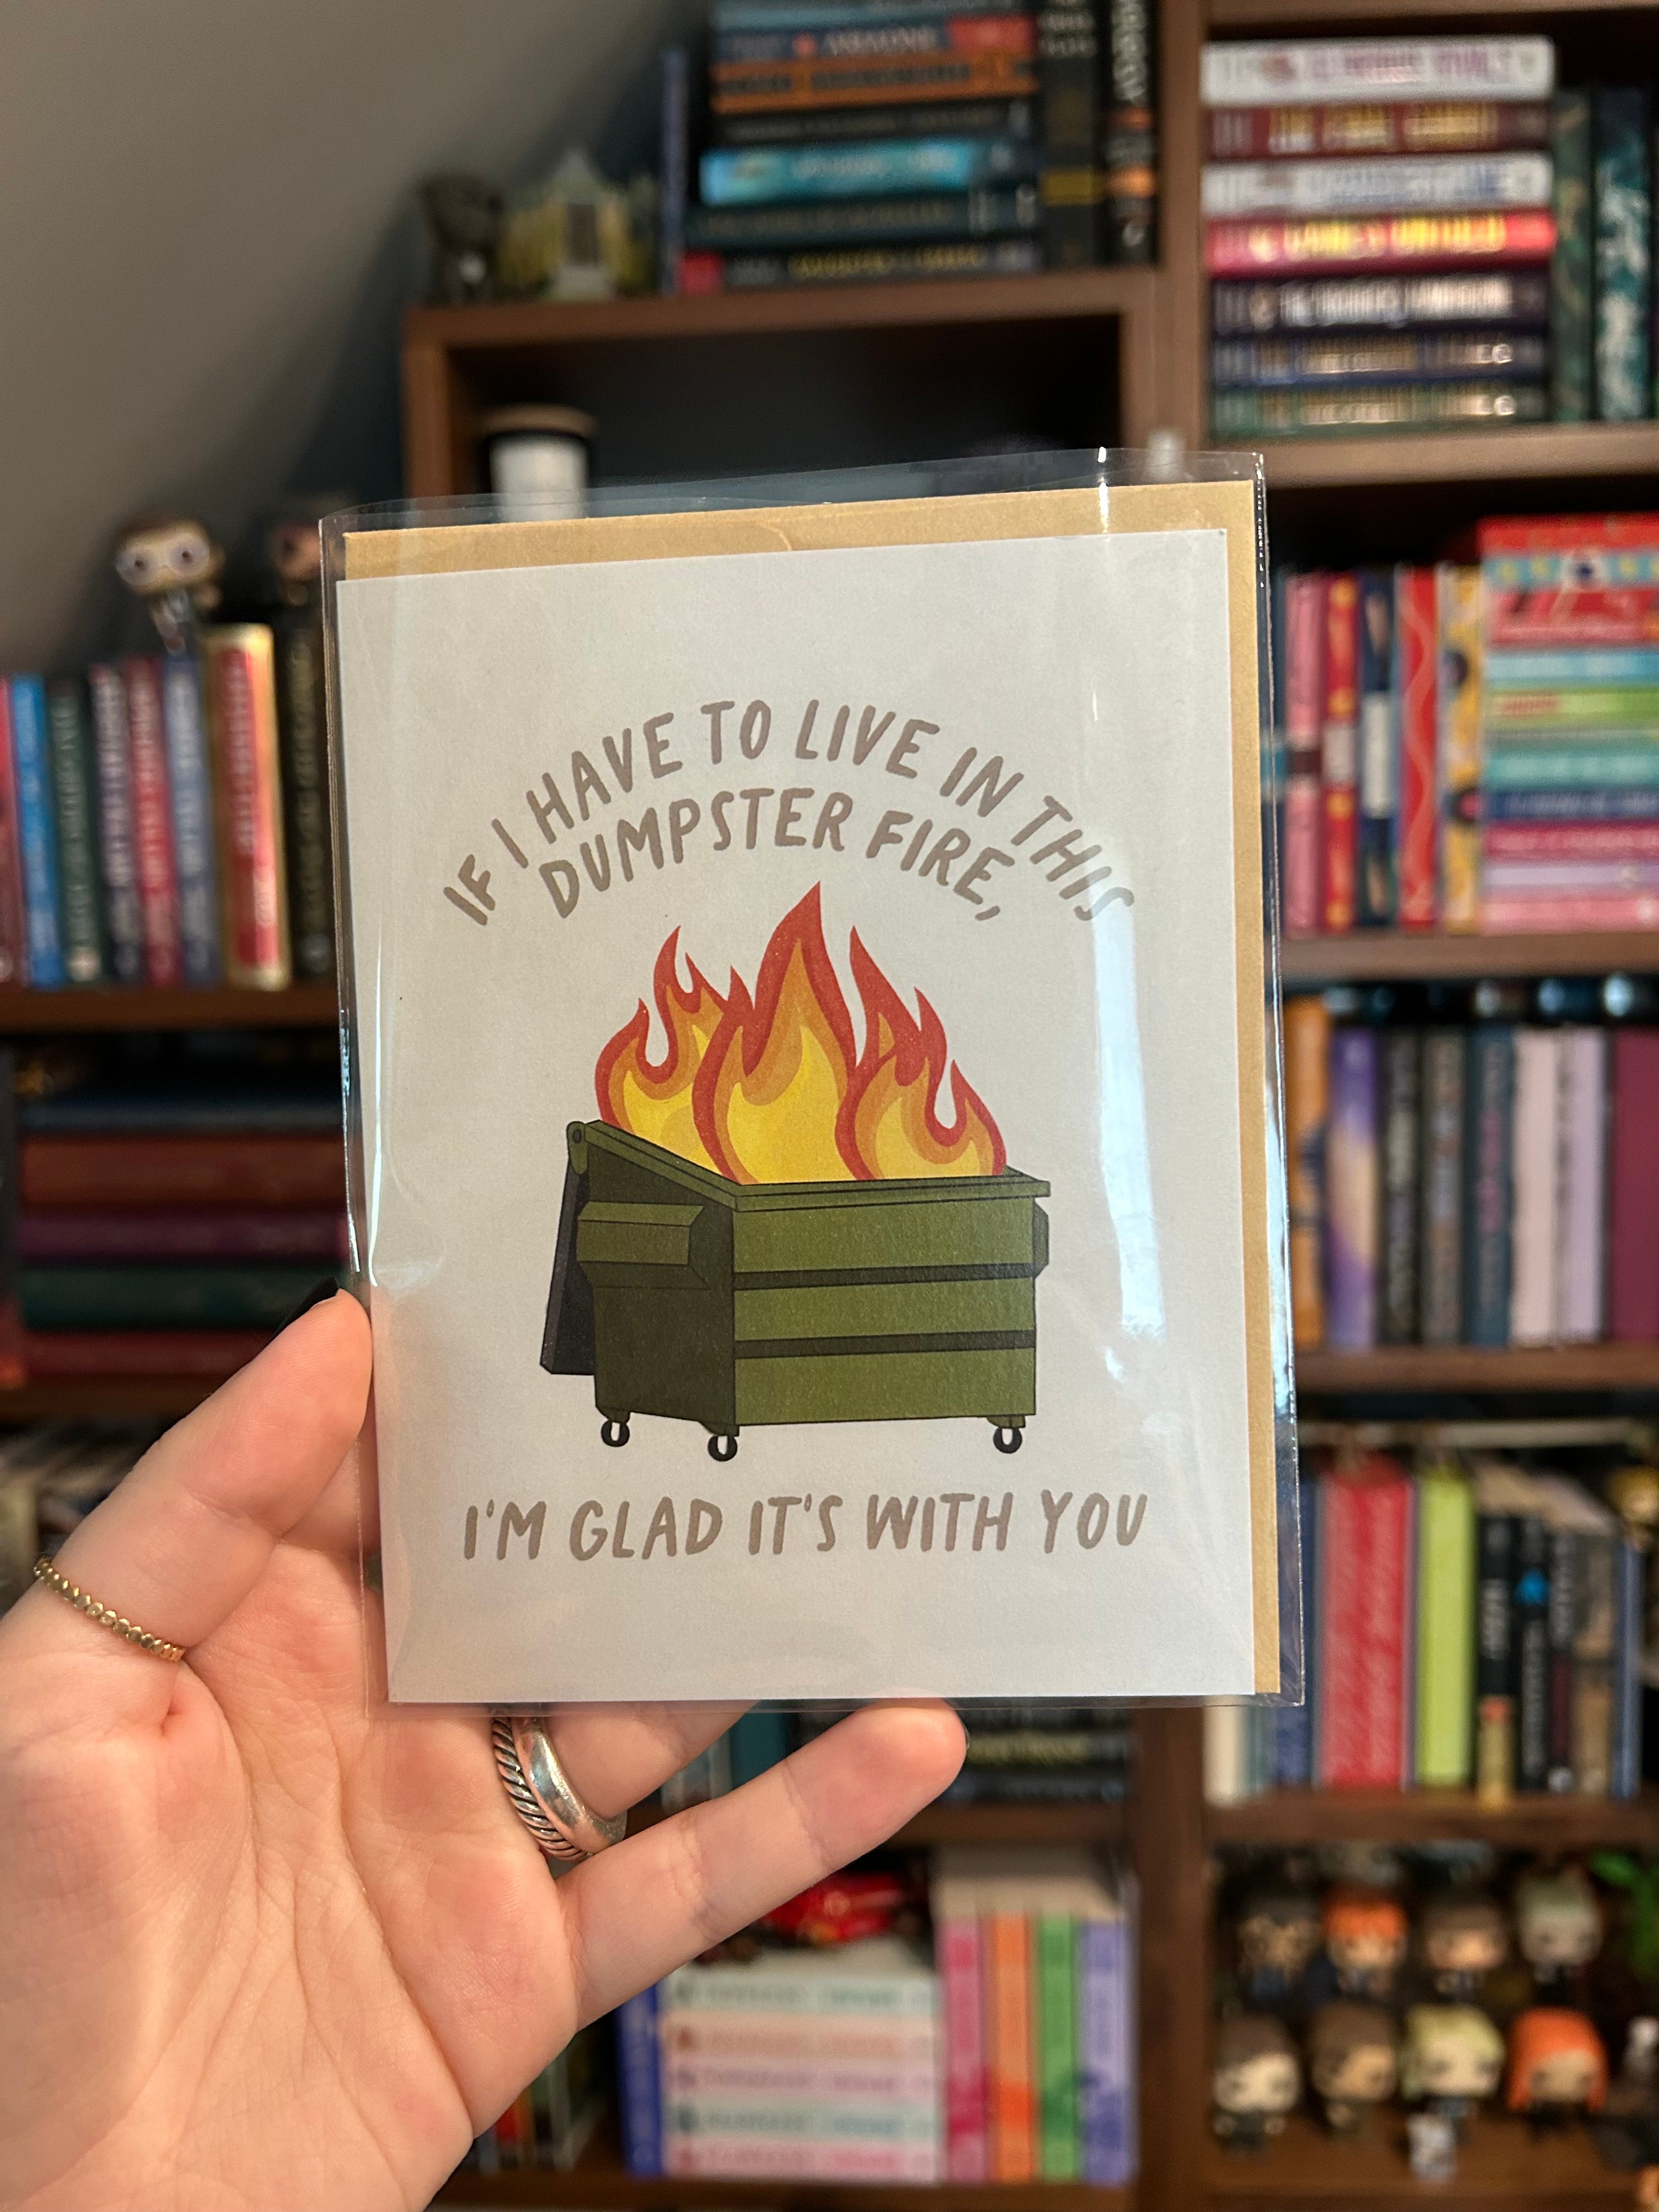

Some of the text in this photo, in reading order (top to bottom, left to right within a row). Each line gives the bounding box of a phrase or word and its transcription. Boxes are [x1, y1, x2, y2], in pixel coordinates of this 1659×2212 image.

[443, 699, 1134, 926] IF I HAVE TO LIVE IN THIS
[539, 788, 1015, 921] DUMPSTER FIRE,
[464, 1489, 1147, 1561] I'M GLAD IT'S WITH YOU
